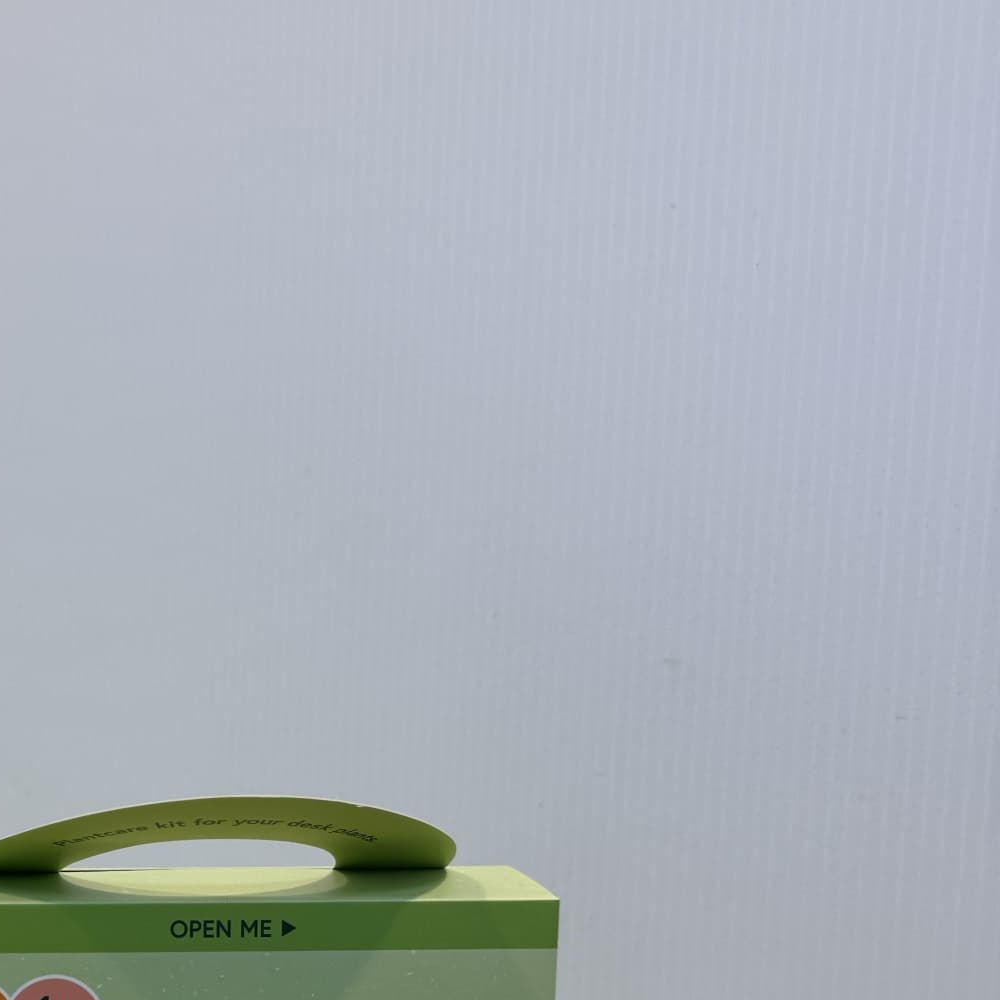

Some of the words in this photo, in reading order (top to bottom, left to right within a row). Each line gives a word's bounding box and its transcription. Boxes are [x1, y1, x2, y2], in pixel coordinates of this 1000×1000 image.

[52, 824, 149, 847] Plantcare
[154, 821, 186, 830] kit
[195, 817, 227, 826] for
[231, 818, 286, 827] your
[287, 820, 334, 831] desk
[169, 919, 232, 938] OPEN
[240, 919, 272, 938] ME
